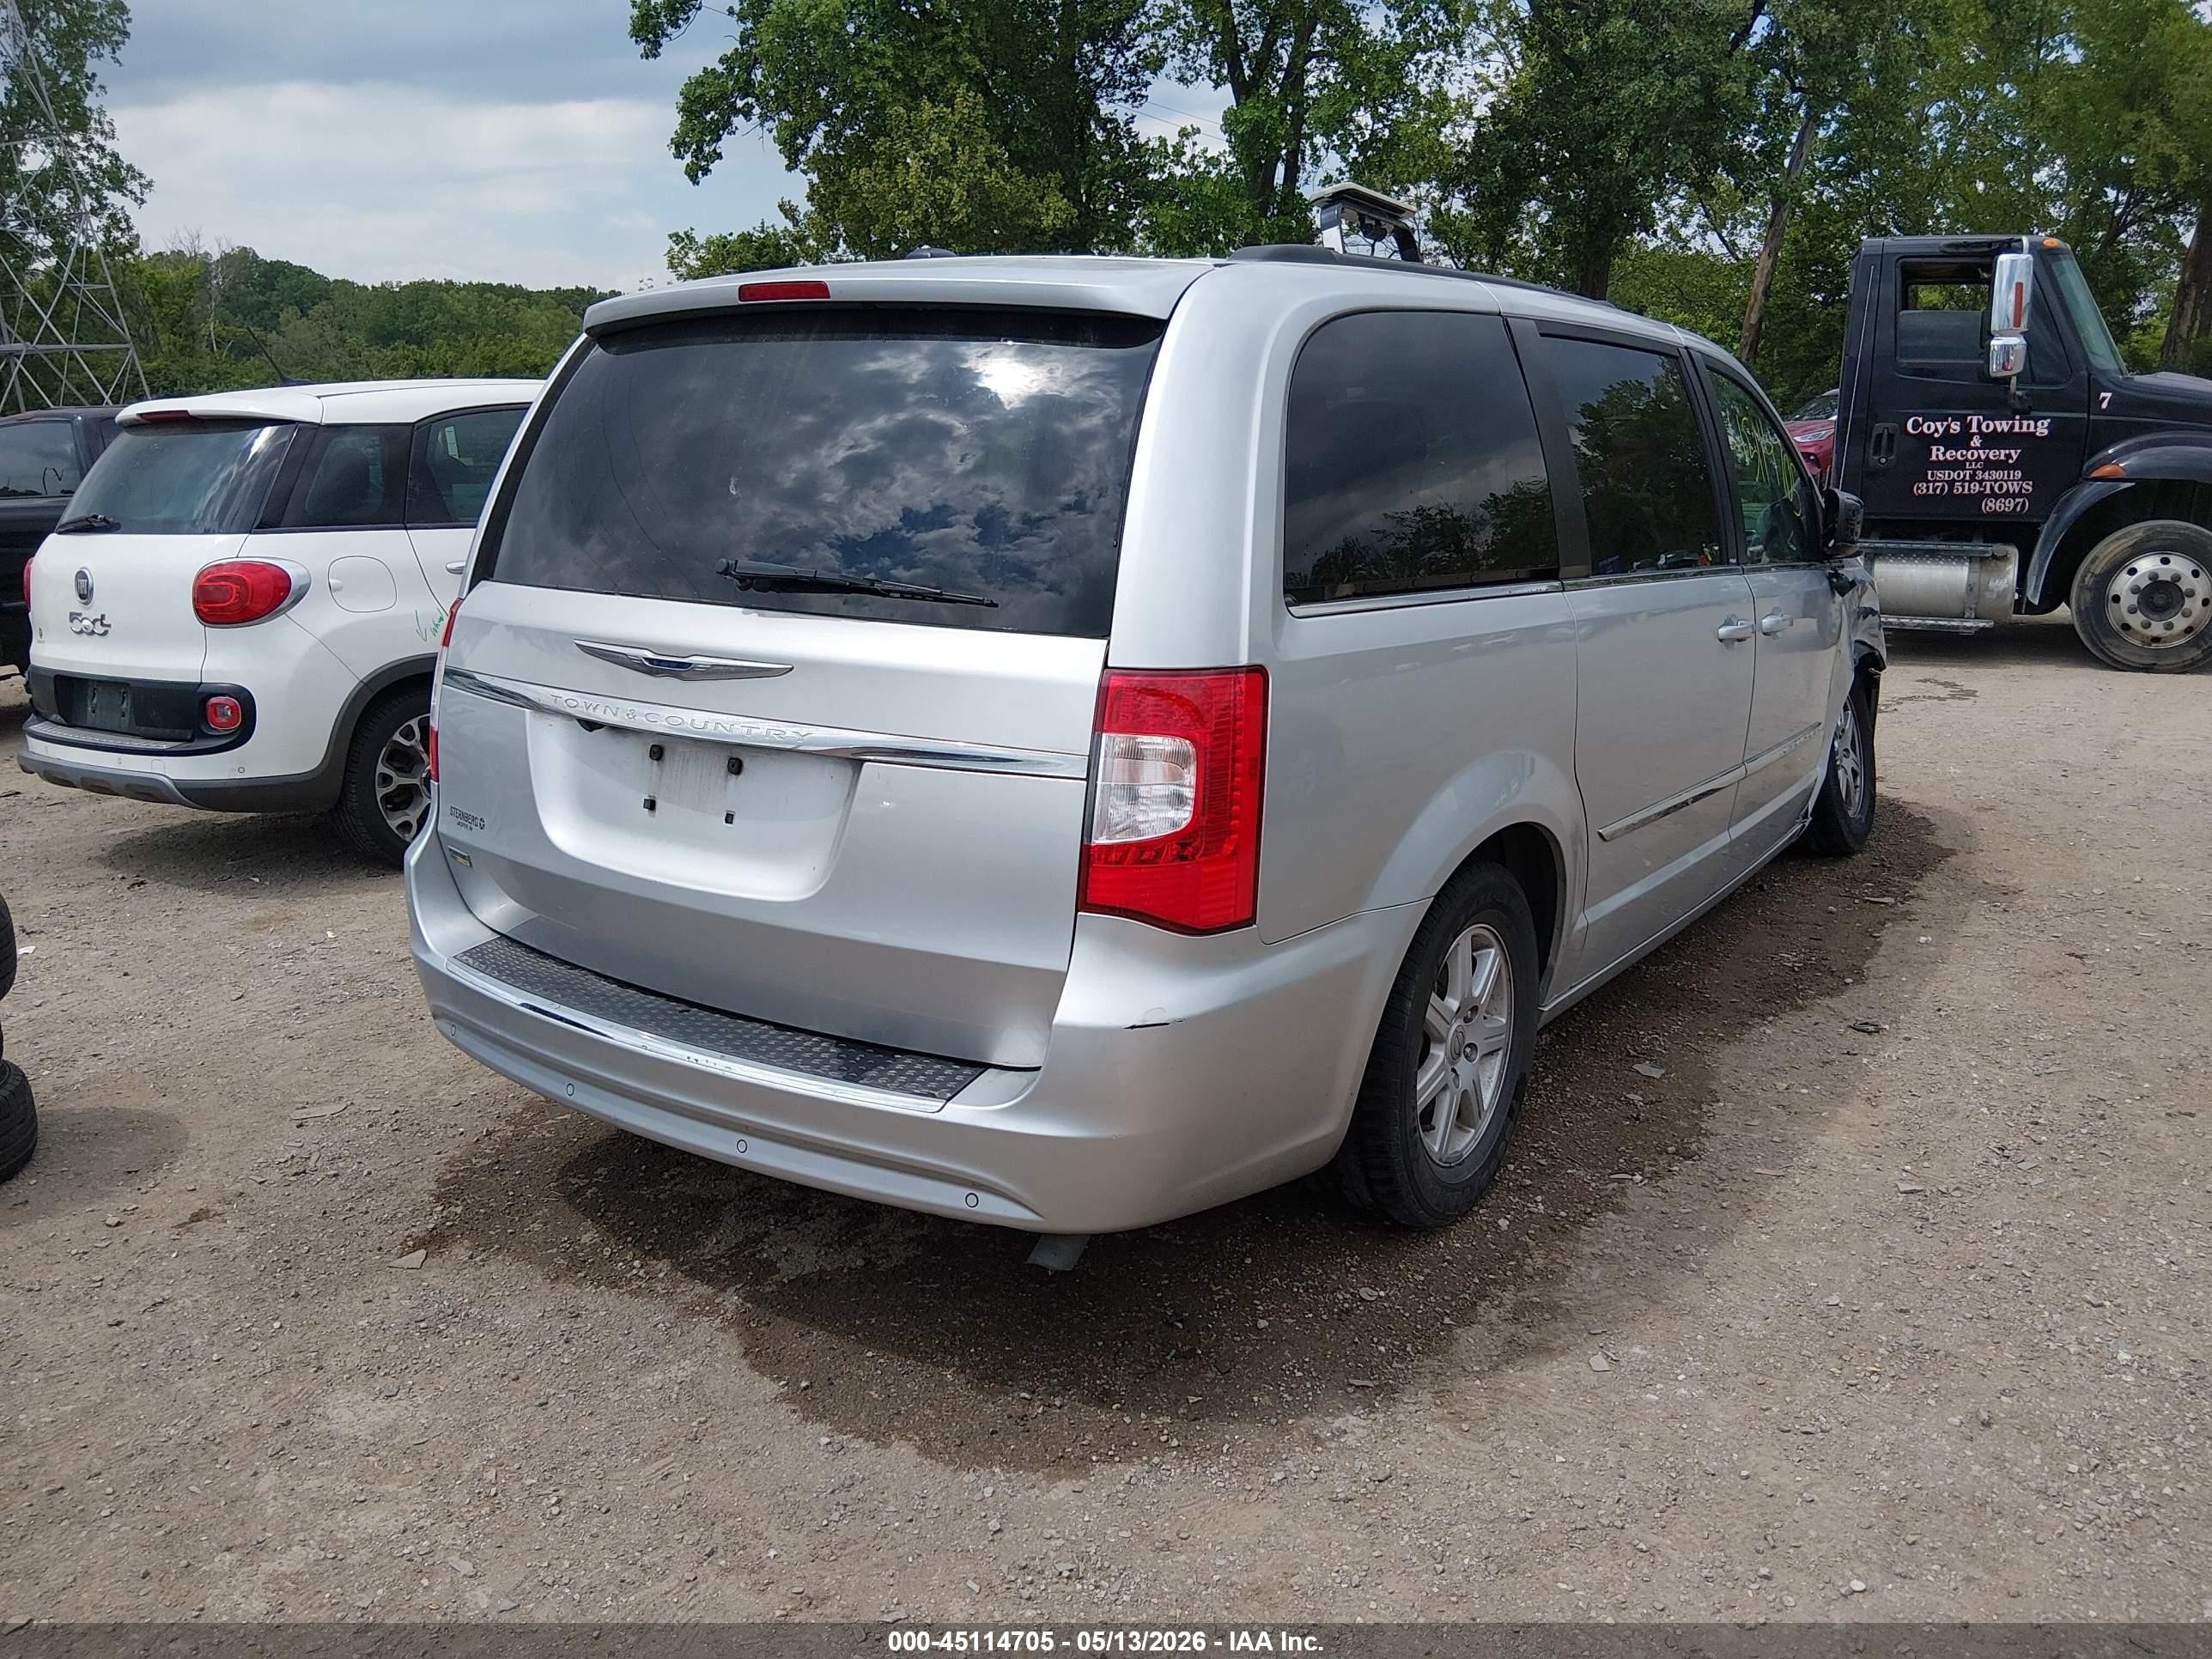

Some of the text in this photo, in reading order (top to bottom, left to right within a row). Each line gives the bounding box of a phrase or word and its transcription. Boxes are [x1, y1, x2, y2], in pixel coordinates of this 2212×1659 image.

[2099, 392, 2112, 410] 7
[1905, 415, 2051, 438] Coy's Towing
[1970, 434, 1983, 447] &
[1929, 446, 2021, 464] Recovery
[1927, 470, 2022, 480] USDOT 3430119
[1913, 481, 2033, 495] (317) 519-TOWS
[1981, 497, 2029, 514] (8697)
[449, 805, 479, 828] STERNBERG
